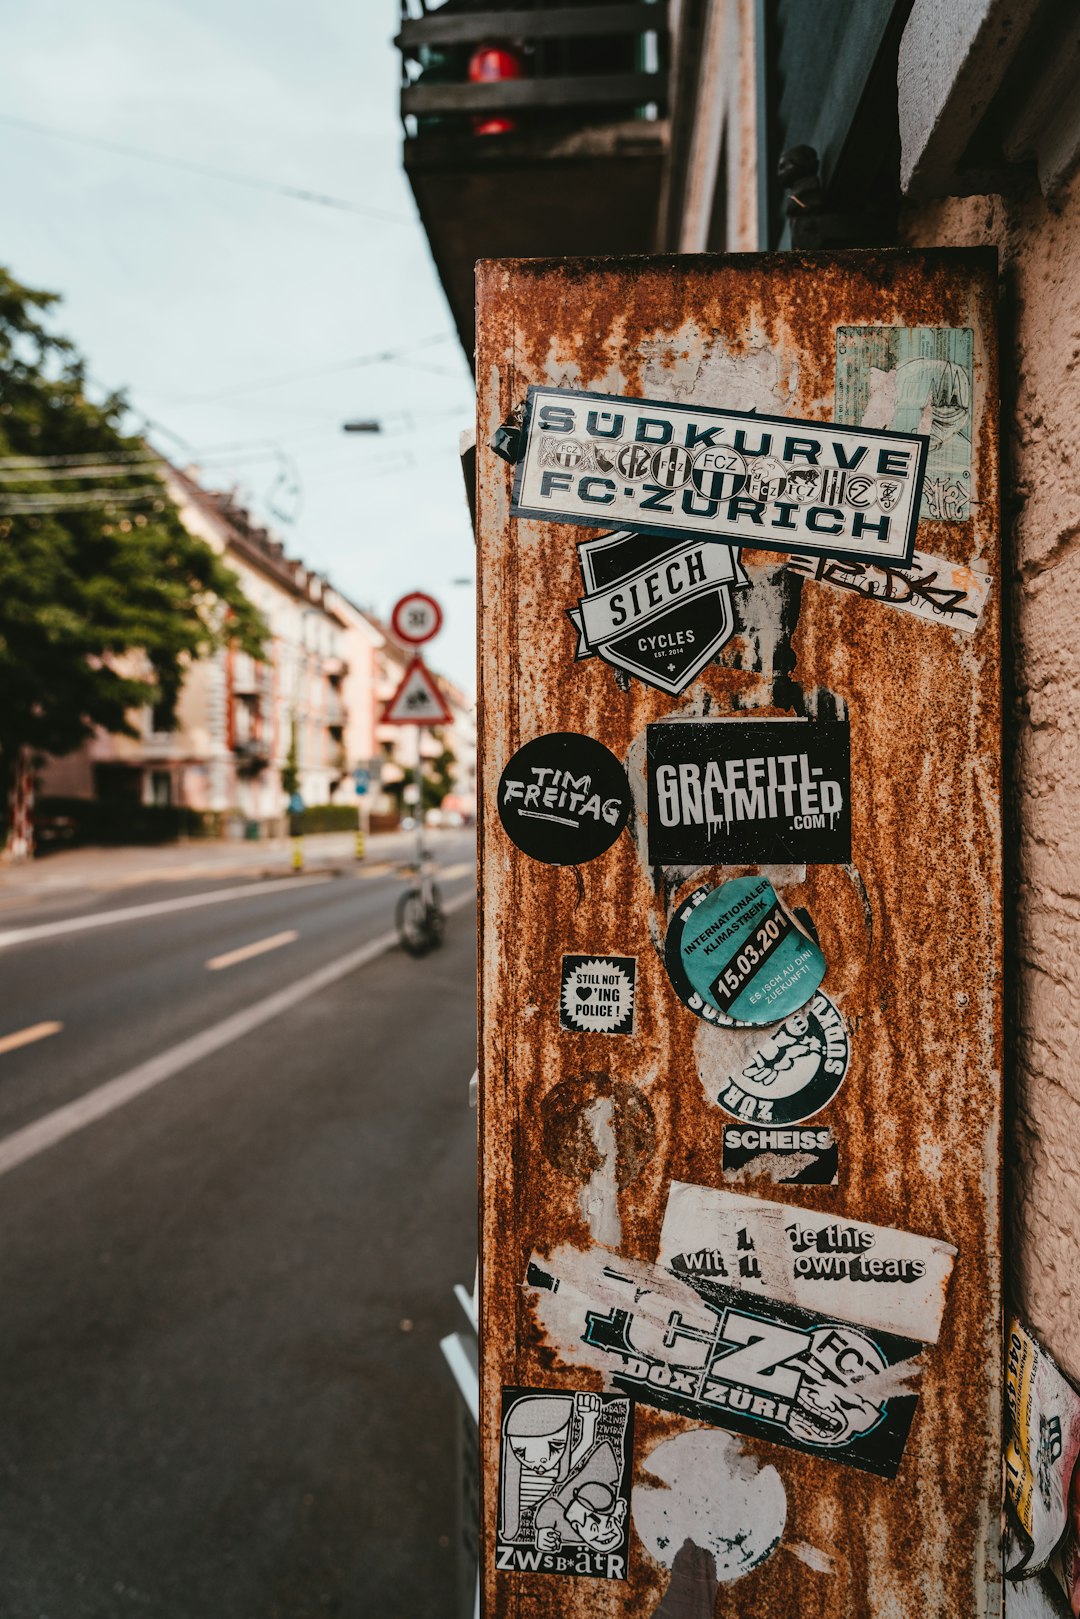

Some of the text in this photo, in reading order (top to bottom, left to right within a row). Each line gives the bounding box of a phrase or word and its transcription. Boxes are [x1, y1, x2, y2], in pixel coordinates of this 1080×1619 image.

[538, 405, 912, 478] SÜDKURVE
[703, 453, 738, 471] FCZ
[609, 550, 707, 626] SIECH
[637, 629, 695, 652] CYCLES
[653, 647, 684, 659] EST. 2014
[531, 767, 592, 795] TIM
[503, 780, 622, 826] FREITAG
[658, 781, 843, 828] UNLIMITED
[789, 814, 826, 831] .COM
[684, 880, 770, 955] INTERNATIONALER
[703, 899, 768, 956] KLIMASTREIK
[717, 909, 788, 998] 15.03.201
[576, 973, 620, 985] STILL NOT
[749, 950, 813, 1004] ES ISCH AU DINI
[765, 964, 811, 1005] ZUEKUNFT!
[575, 1004, 613, 1017] POLICE
[725, 1130, 834, 1150] SCHEISS
[827, 1224, 876, 1249] this
[684, 1248, 728, 1271] wit
[795, 1256, 849, 1274] own
[860, 1253, 927, 1278] tears
[1008, 1333, 1022, 1379] 044
[1029, 1349, 1038, 1384] PASTA
